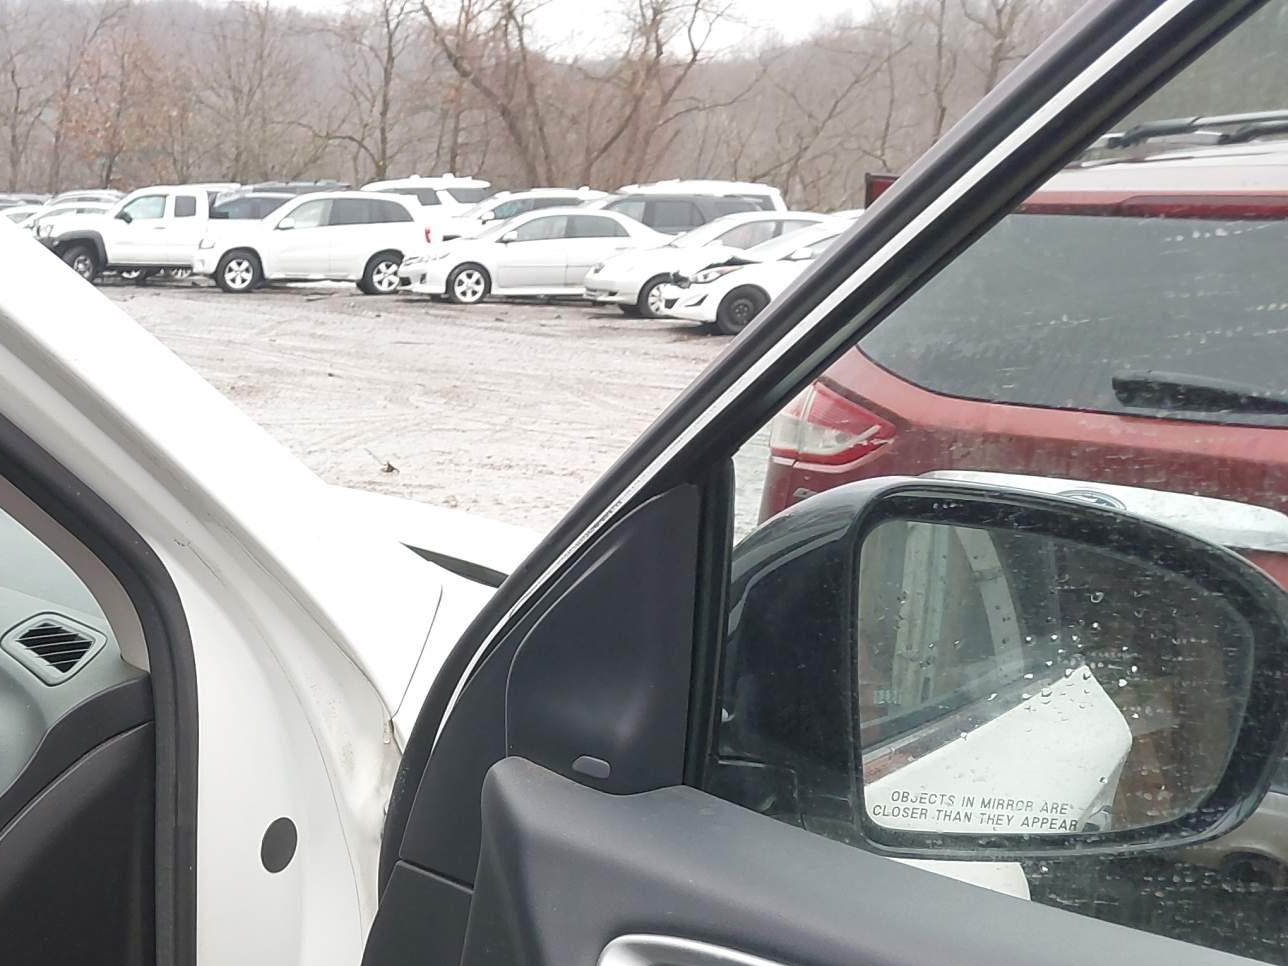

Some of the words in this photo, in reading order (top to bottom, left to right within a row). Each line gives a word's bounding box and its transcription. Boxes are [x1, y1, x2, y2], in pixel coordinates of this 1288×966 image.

[891, 790, 956, 807] OBJECTS
[961, 796, 975, 808] IN
[980, 797, 1034, 812] MIRROR
[1039, 801, 1069, 815] ARE
[872, 804, 928, 820] CLOSER
[936, 809, 973, 824] THAN
[979, 812, 1015, 827] THEY
[1020, 816, 1079, 832] APPEAR
